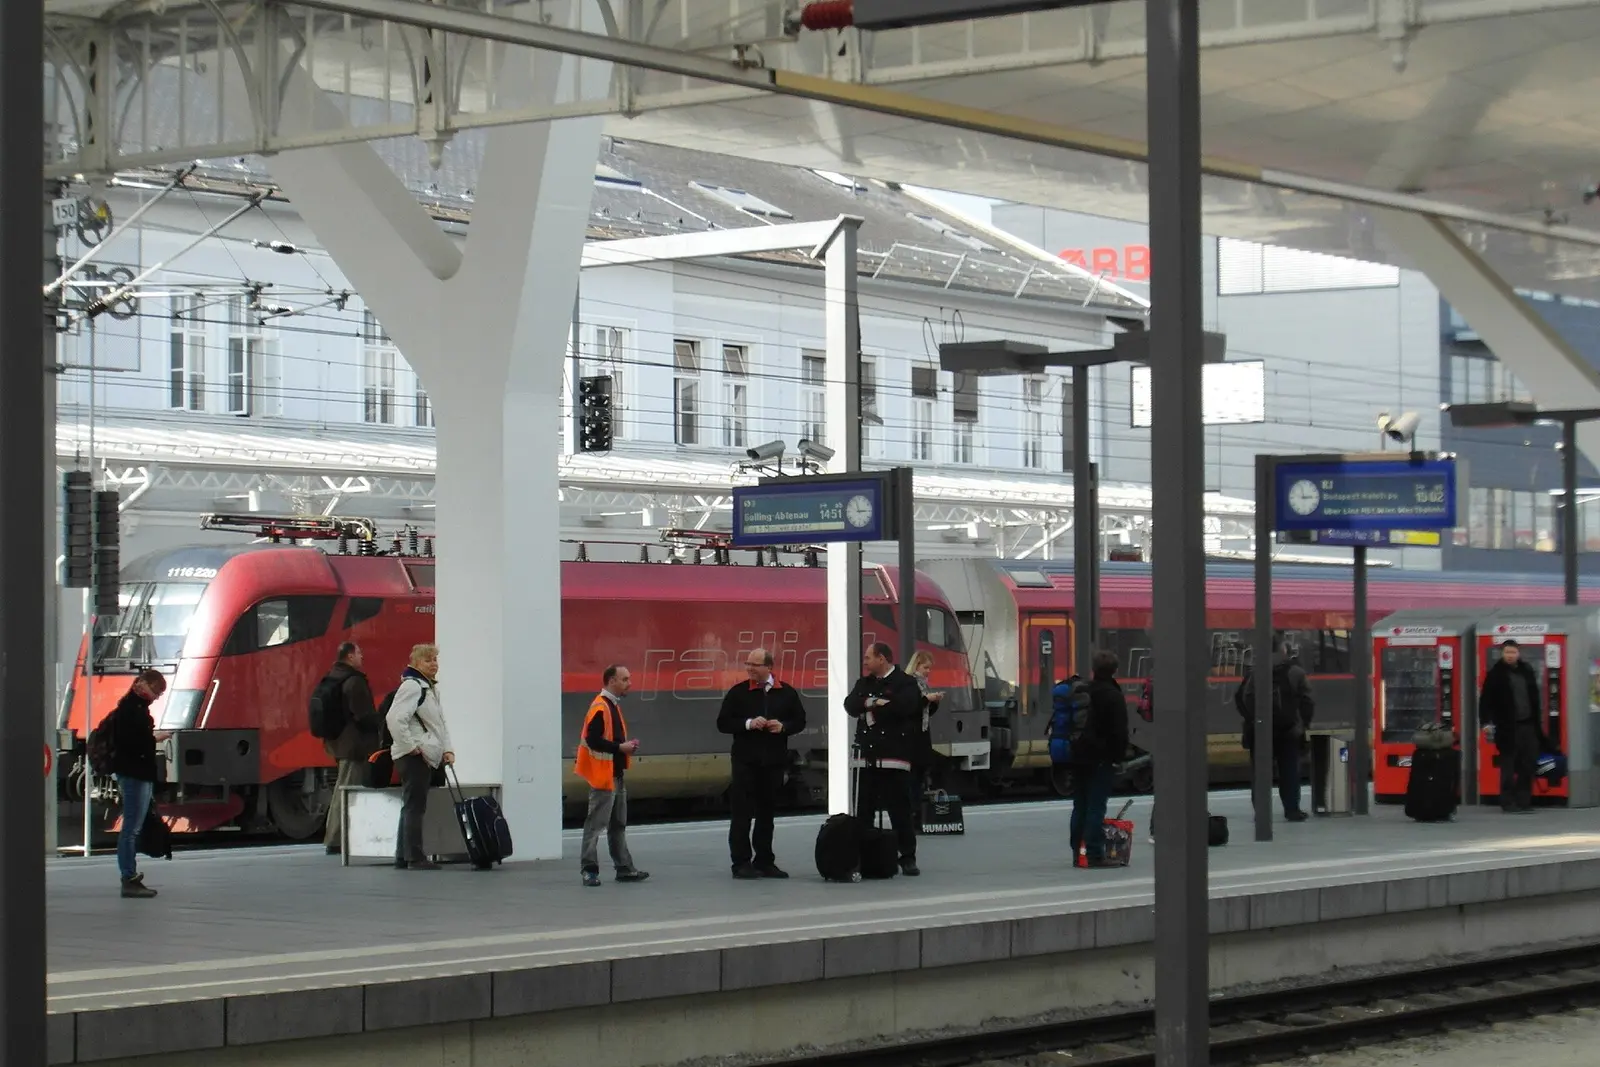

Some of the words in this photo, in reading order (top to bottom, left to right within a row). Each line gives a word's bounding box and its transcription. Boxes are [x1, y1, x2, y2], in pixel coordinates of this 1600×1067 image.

[56, 204, 75, 218] 150
[1042, 640, 1052, 654] 2
[922, 822, 963, 833] HUMANIC
